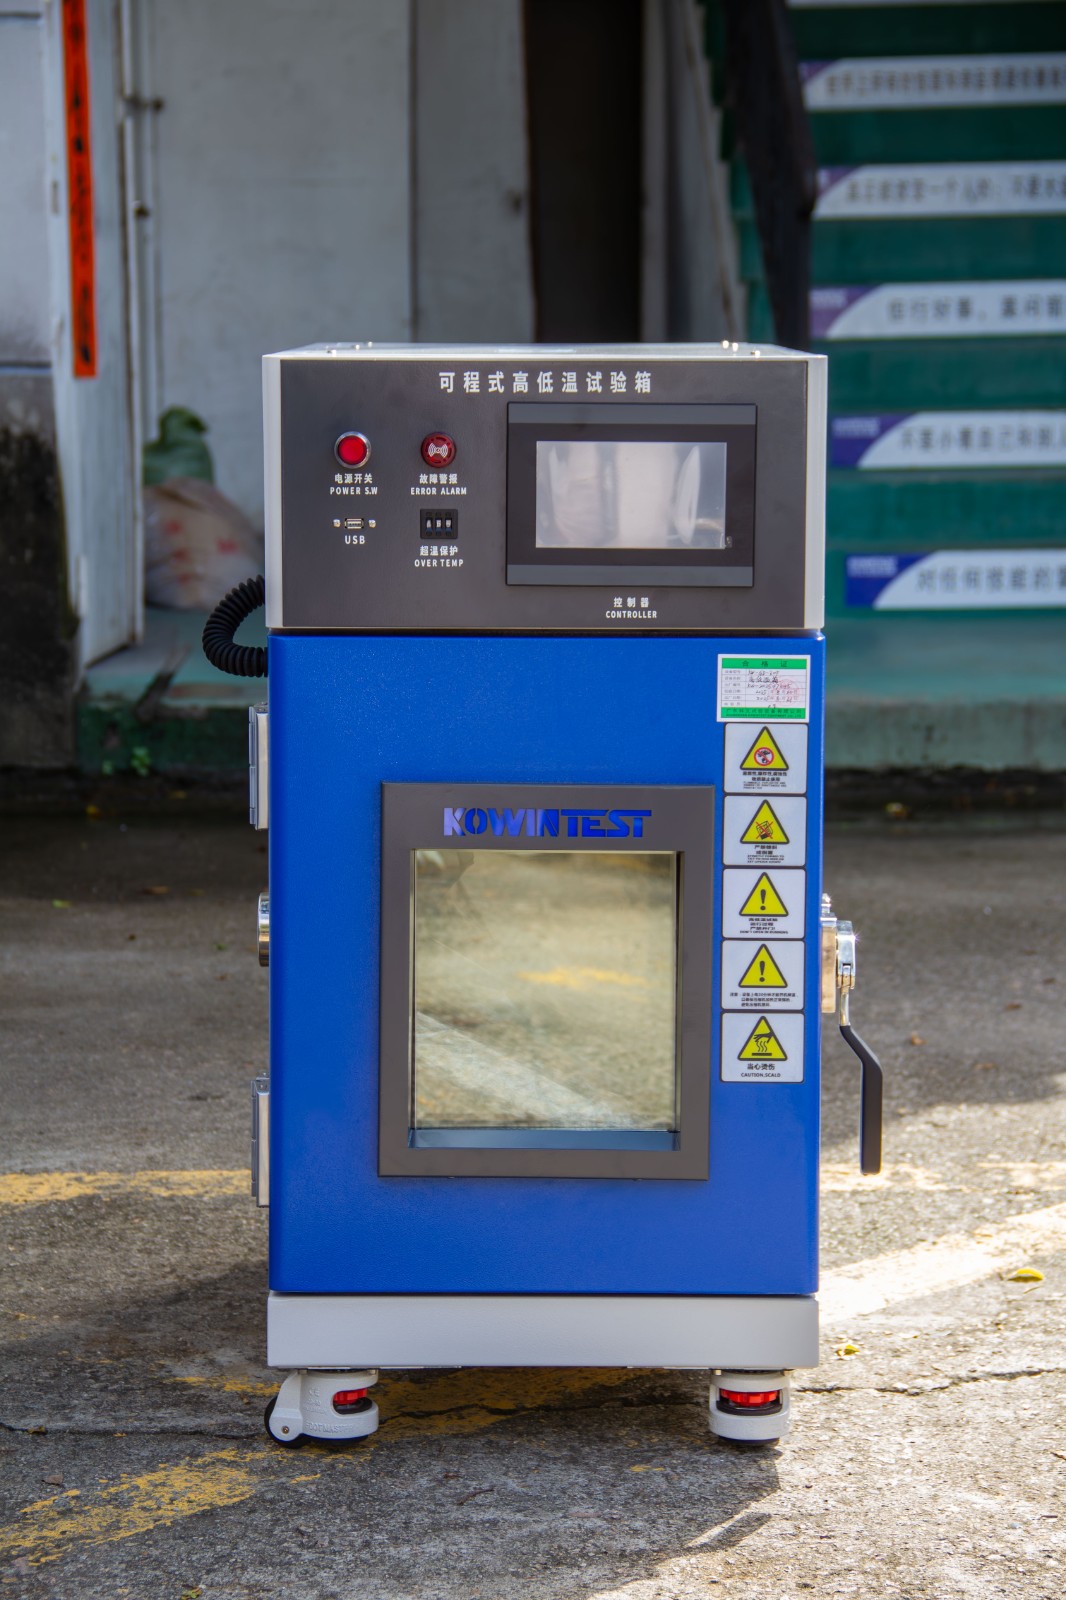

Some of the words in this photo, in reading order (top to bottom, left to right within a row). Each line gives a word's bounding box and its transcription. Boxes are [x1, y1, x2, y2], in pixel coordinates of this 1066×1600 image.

[439, 371, 652, 394] 可程式高低温试验箱
[334, 473, 373, 484] 电源开关
[419, 473, 458, 484] 故障警报
[330, 486, 361, 495] POWER
[364, 486, 378, 495] S.W
[410, 487, 437, 495] ERROR
[440, 487, 467, 495] ALARM
[344, 535, 366, 545] USB
[419, 545, 458, 557] 超温保护
[414, 558, 438, 567] OVER
[440, 558, 464, 567] TEMP
[613, 597, 650, 607] 控制器
[605, 610, 658, 619] CONTROLLER
[443, 807, 652, 838] KOWINTEST
